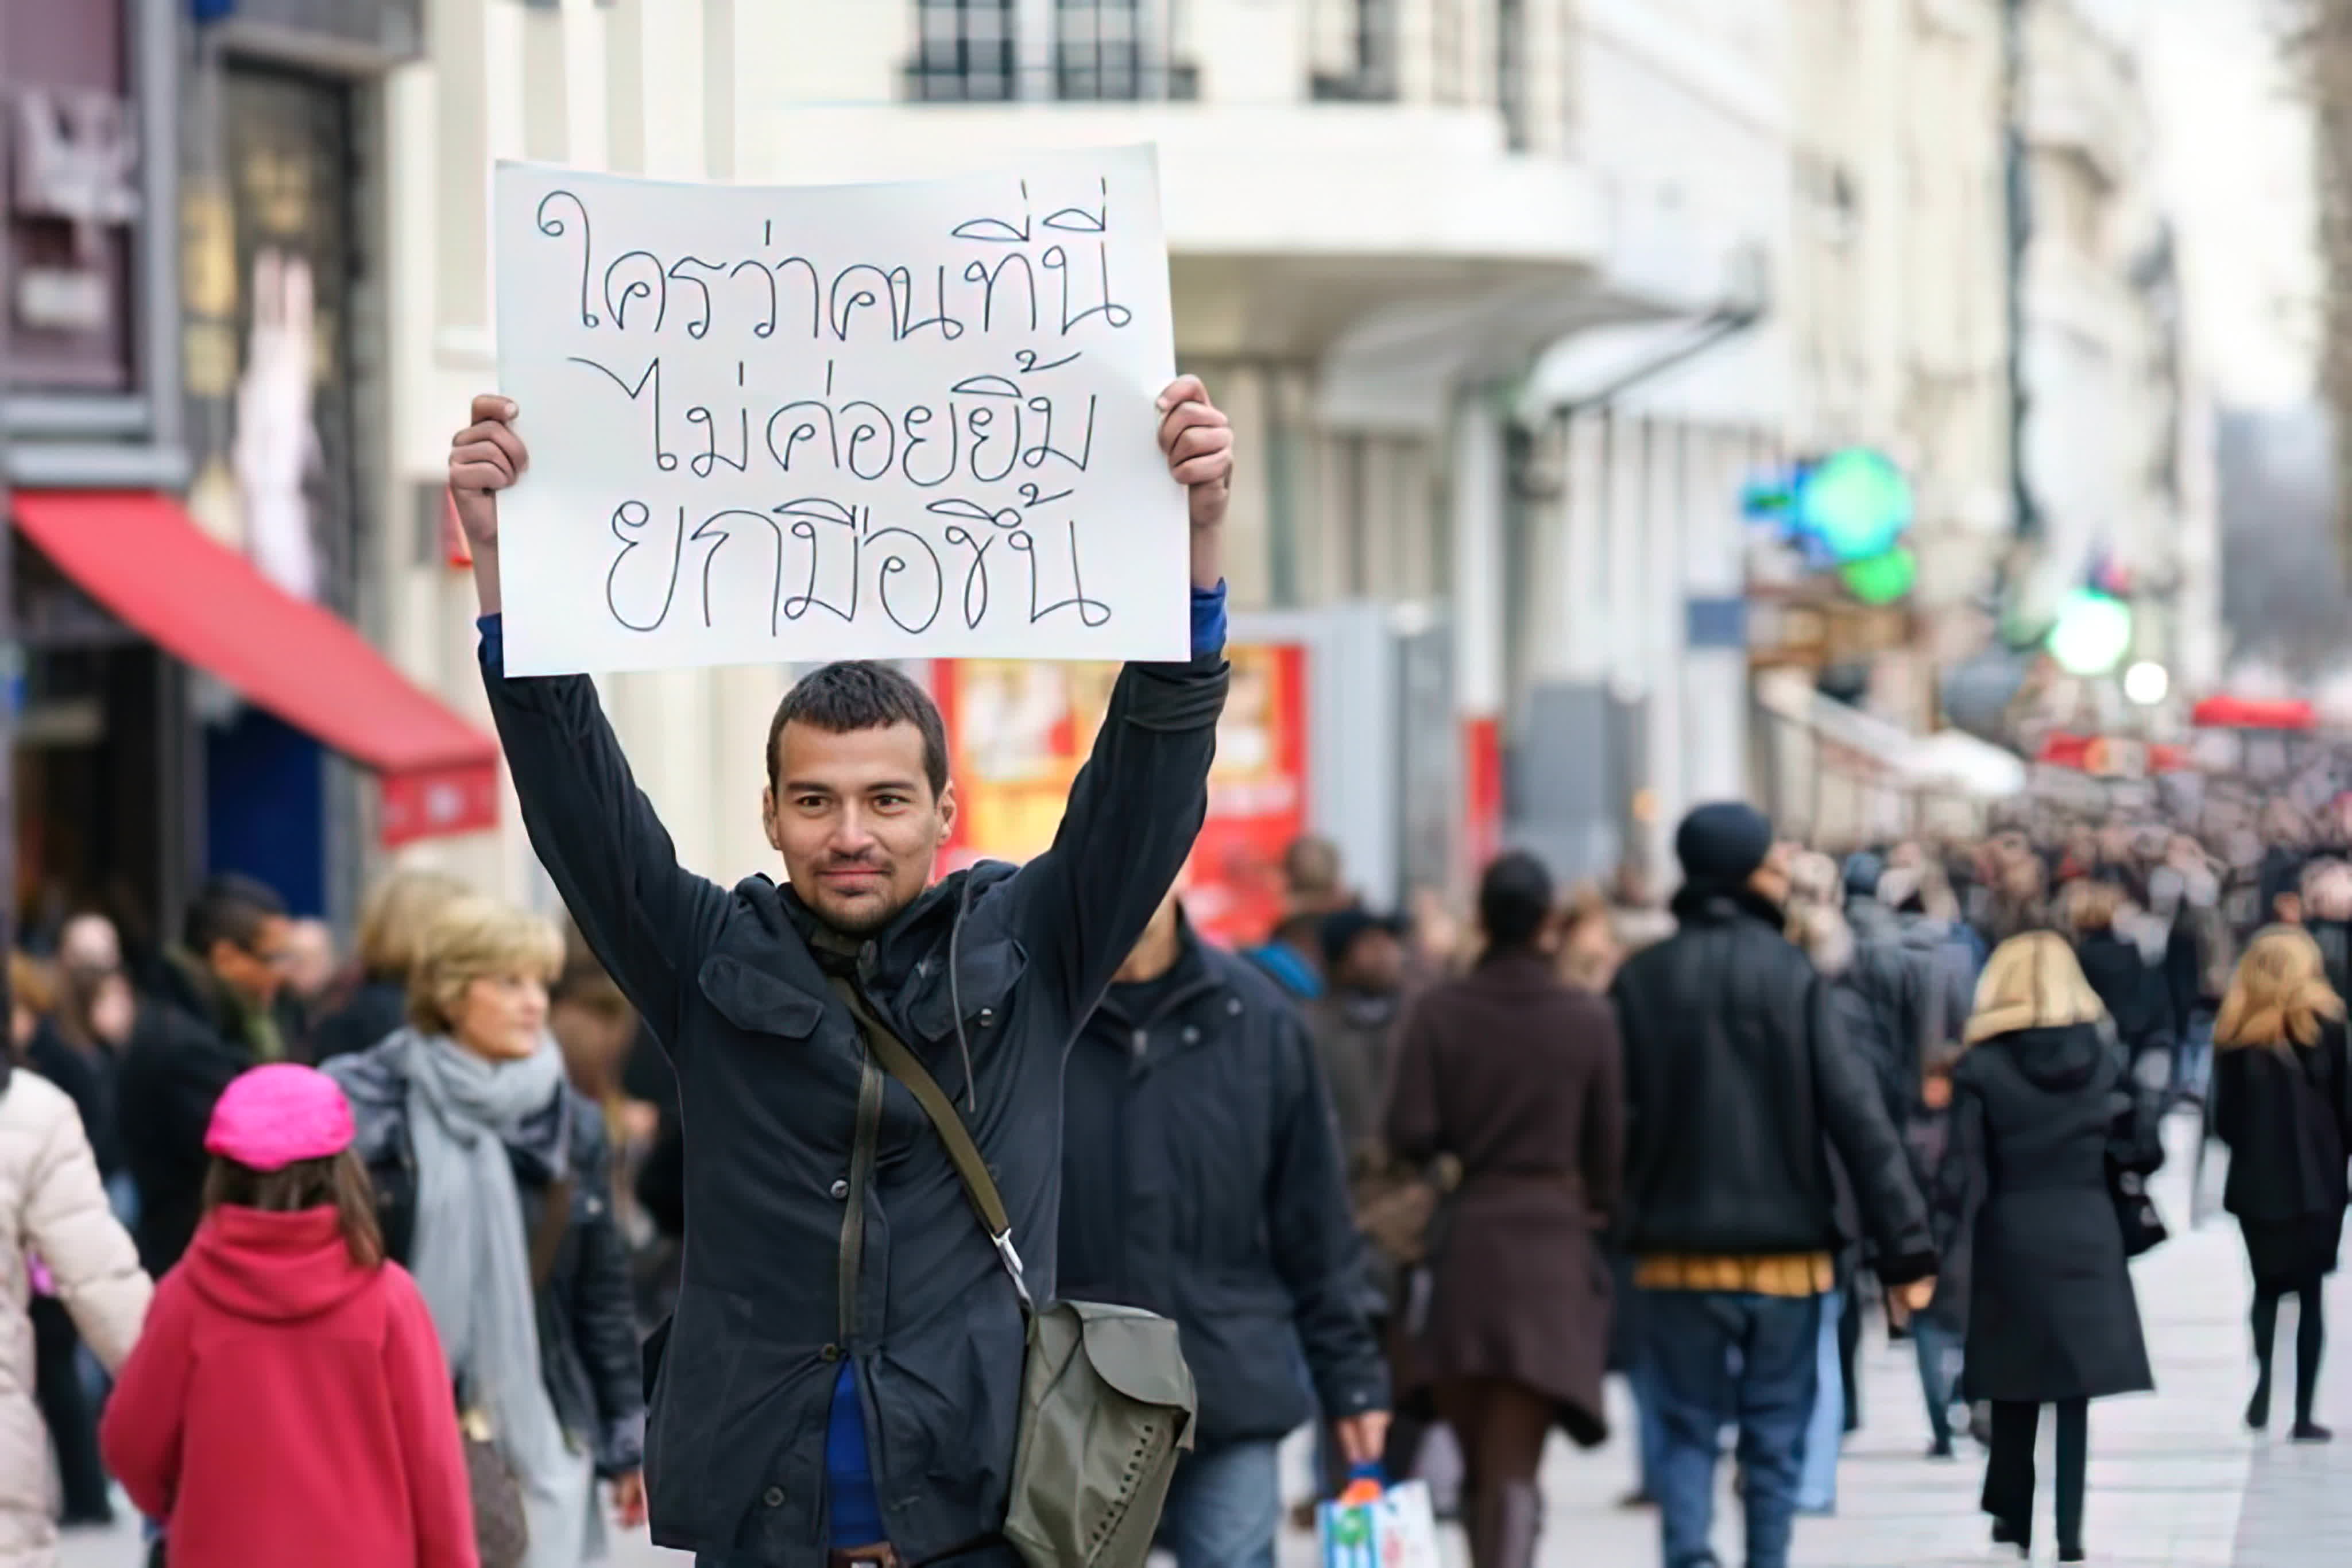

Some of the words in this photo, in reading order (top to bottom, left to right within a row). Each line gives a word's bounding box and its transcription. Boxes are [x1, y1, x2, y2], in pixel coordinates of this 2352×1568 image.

[537, 176, 1132, 342] ใครว่าคนที่นี่
[567, 349, 1097, 487] ไม่ค่อยยิ้ม
[606, 481, 1112, 638] ยกมือขึ้น
